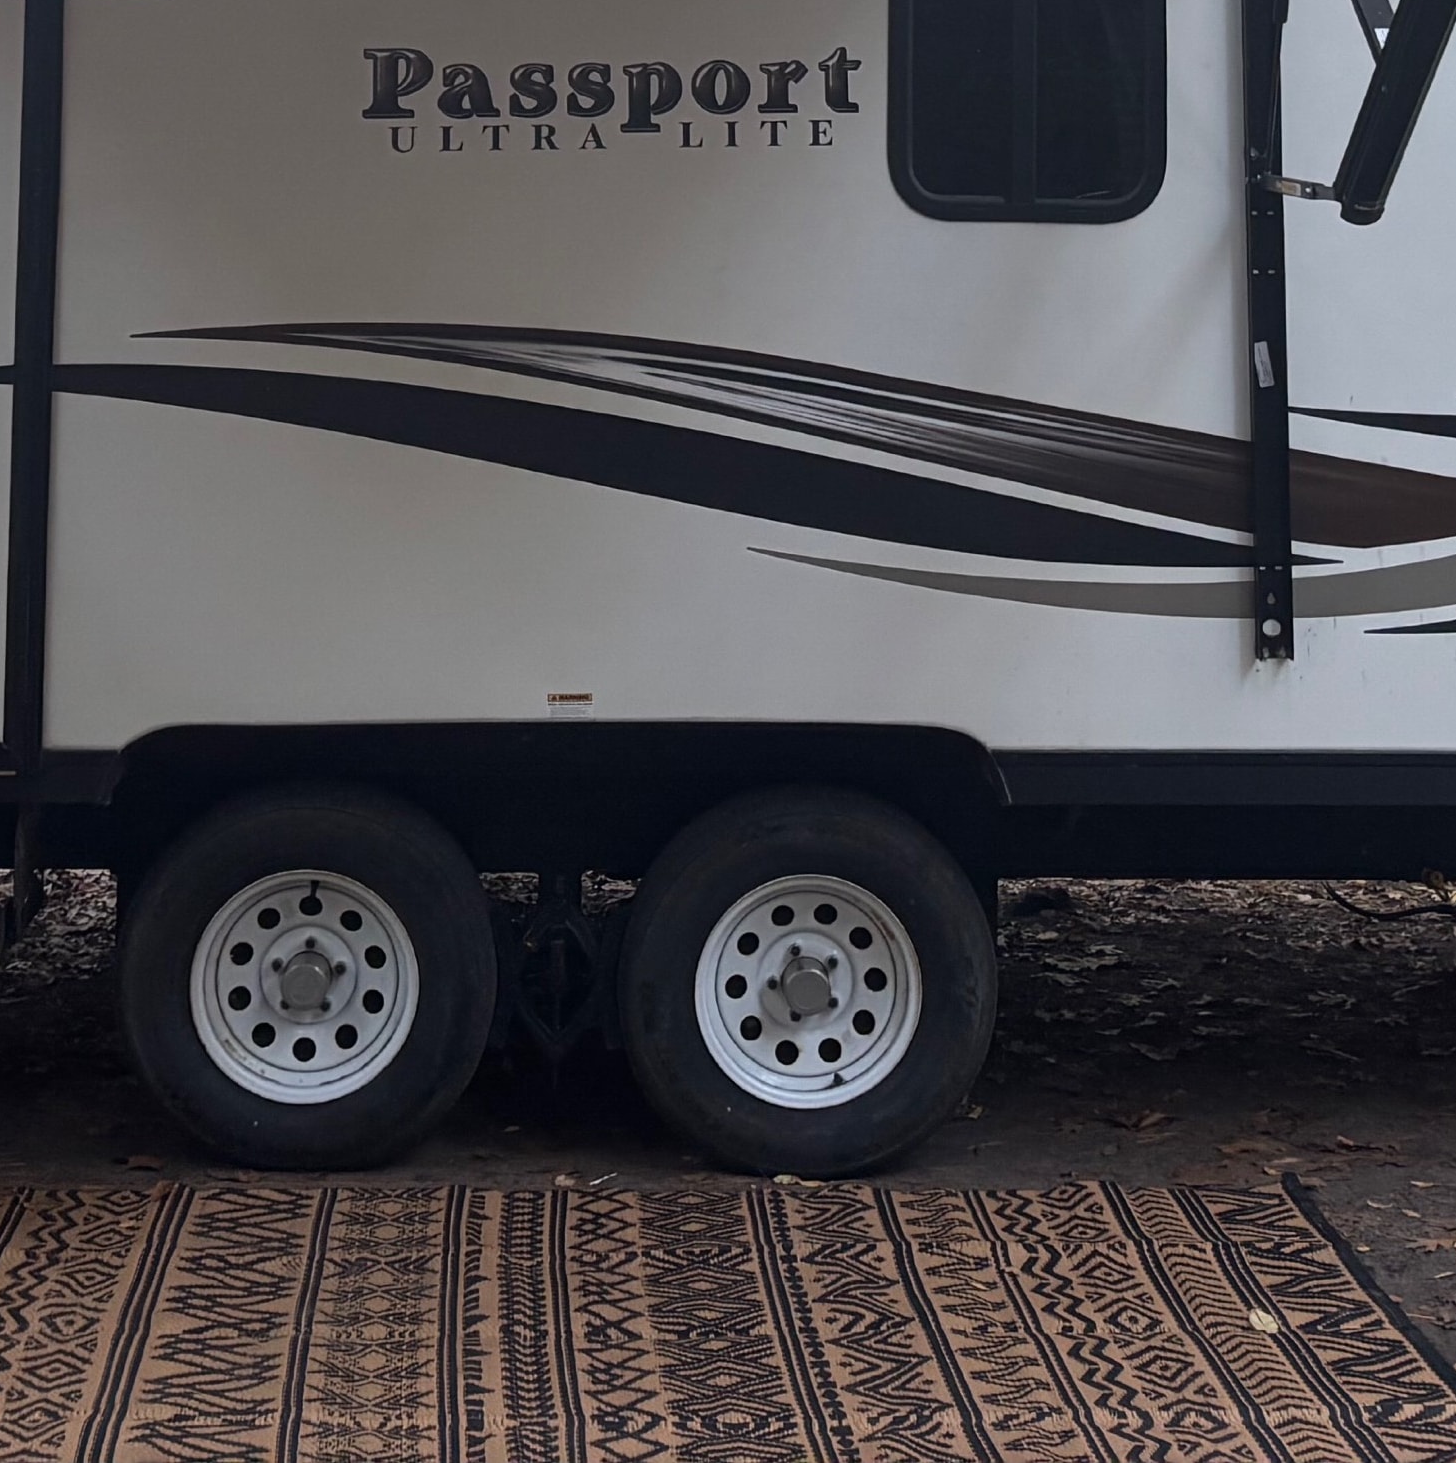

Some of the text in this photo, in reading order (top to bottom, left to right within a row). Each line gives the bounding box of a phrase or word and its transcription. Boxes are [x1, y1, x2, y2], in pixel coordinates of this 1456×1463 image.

[361, 46, 862, 134] Passport
[388, 119, 835, 153] ULTRA LITE
